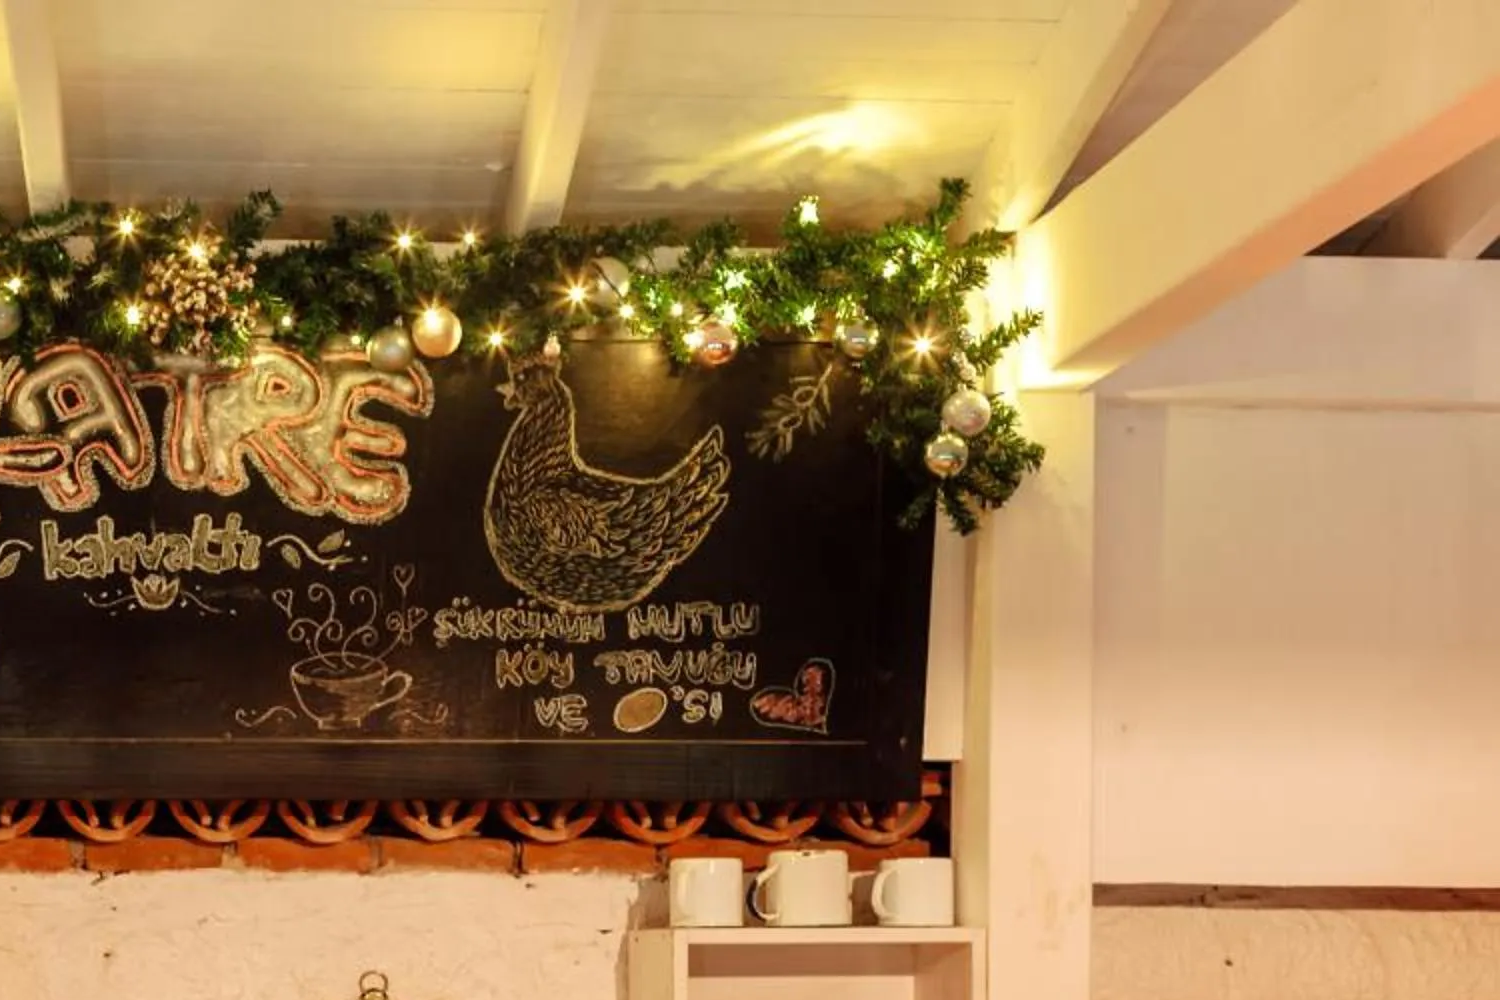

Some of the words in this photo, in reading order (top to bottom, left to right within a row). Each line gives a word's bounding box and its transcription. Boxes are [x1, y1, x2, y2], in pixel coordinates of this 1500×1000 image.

[627, 600, 760, 643] MUTLU
[495, 643, 575, 689] KÖY
[533, 694, 590, 732] VE
